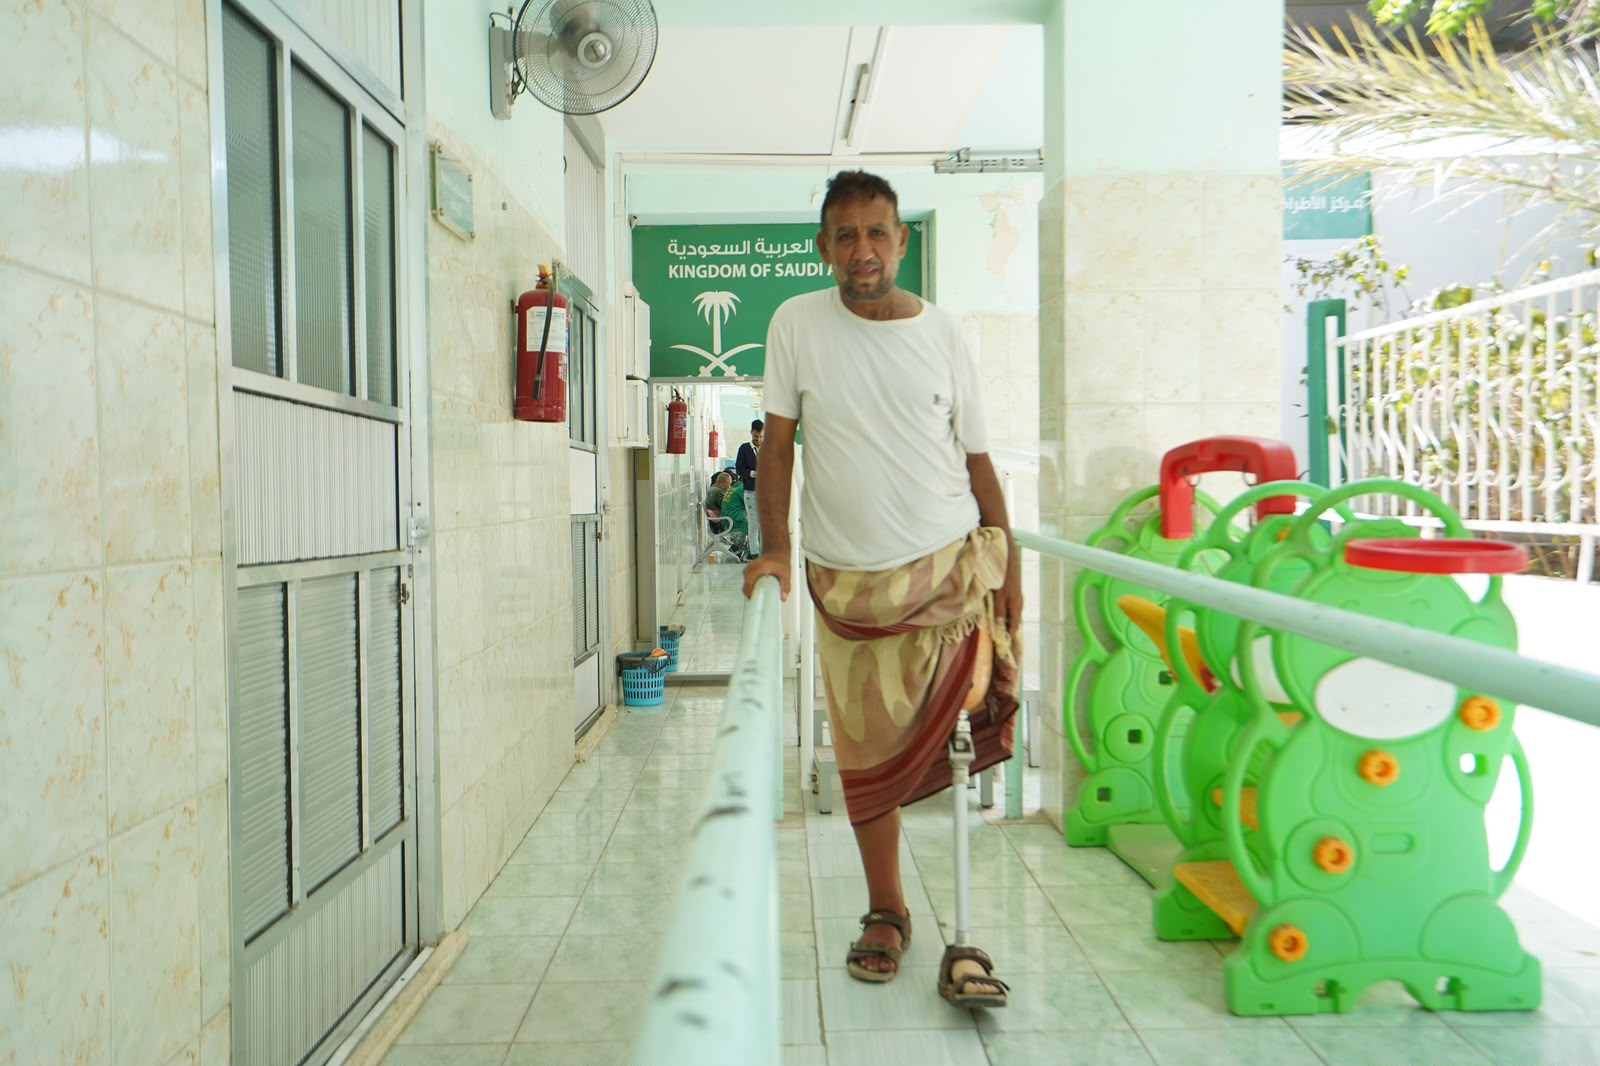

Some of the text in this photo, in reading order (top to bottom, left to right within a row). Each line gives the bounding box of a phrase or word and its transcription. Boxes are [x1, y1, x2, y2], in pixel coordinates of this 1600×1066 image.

[1327, 196, 1365, 214] مركز
[667, 237, 813, 260] العربية السعودية
[668, 263, 747, 279] KINGDOM
[750, 262, 772, 278] OF
[774, 262, 824, 278] SAUDI
